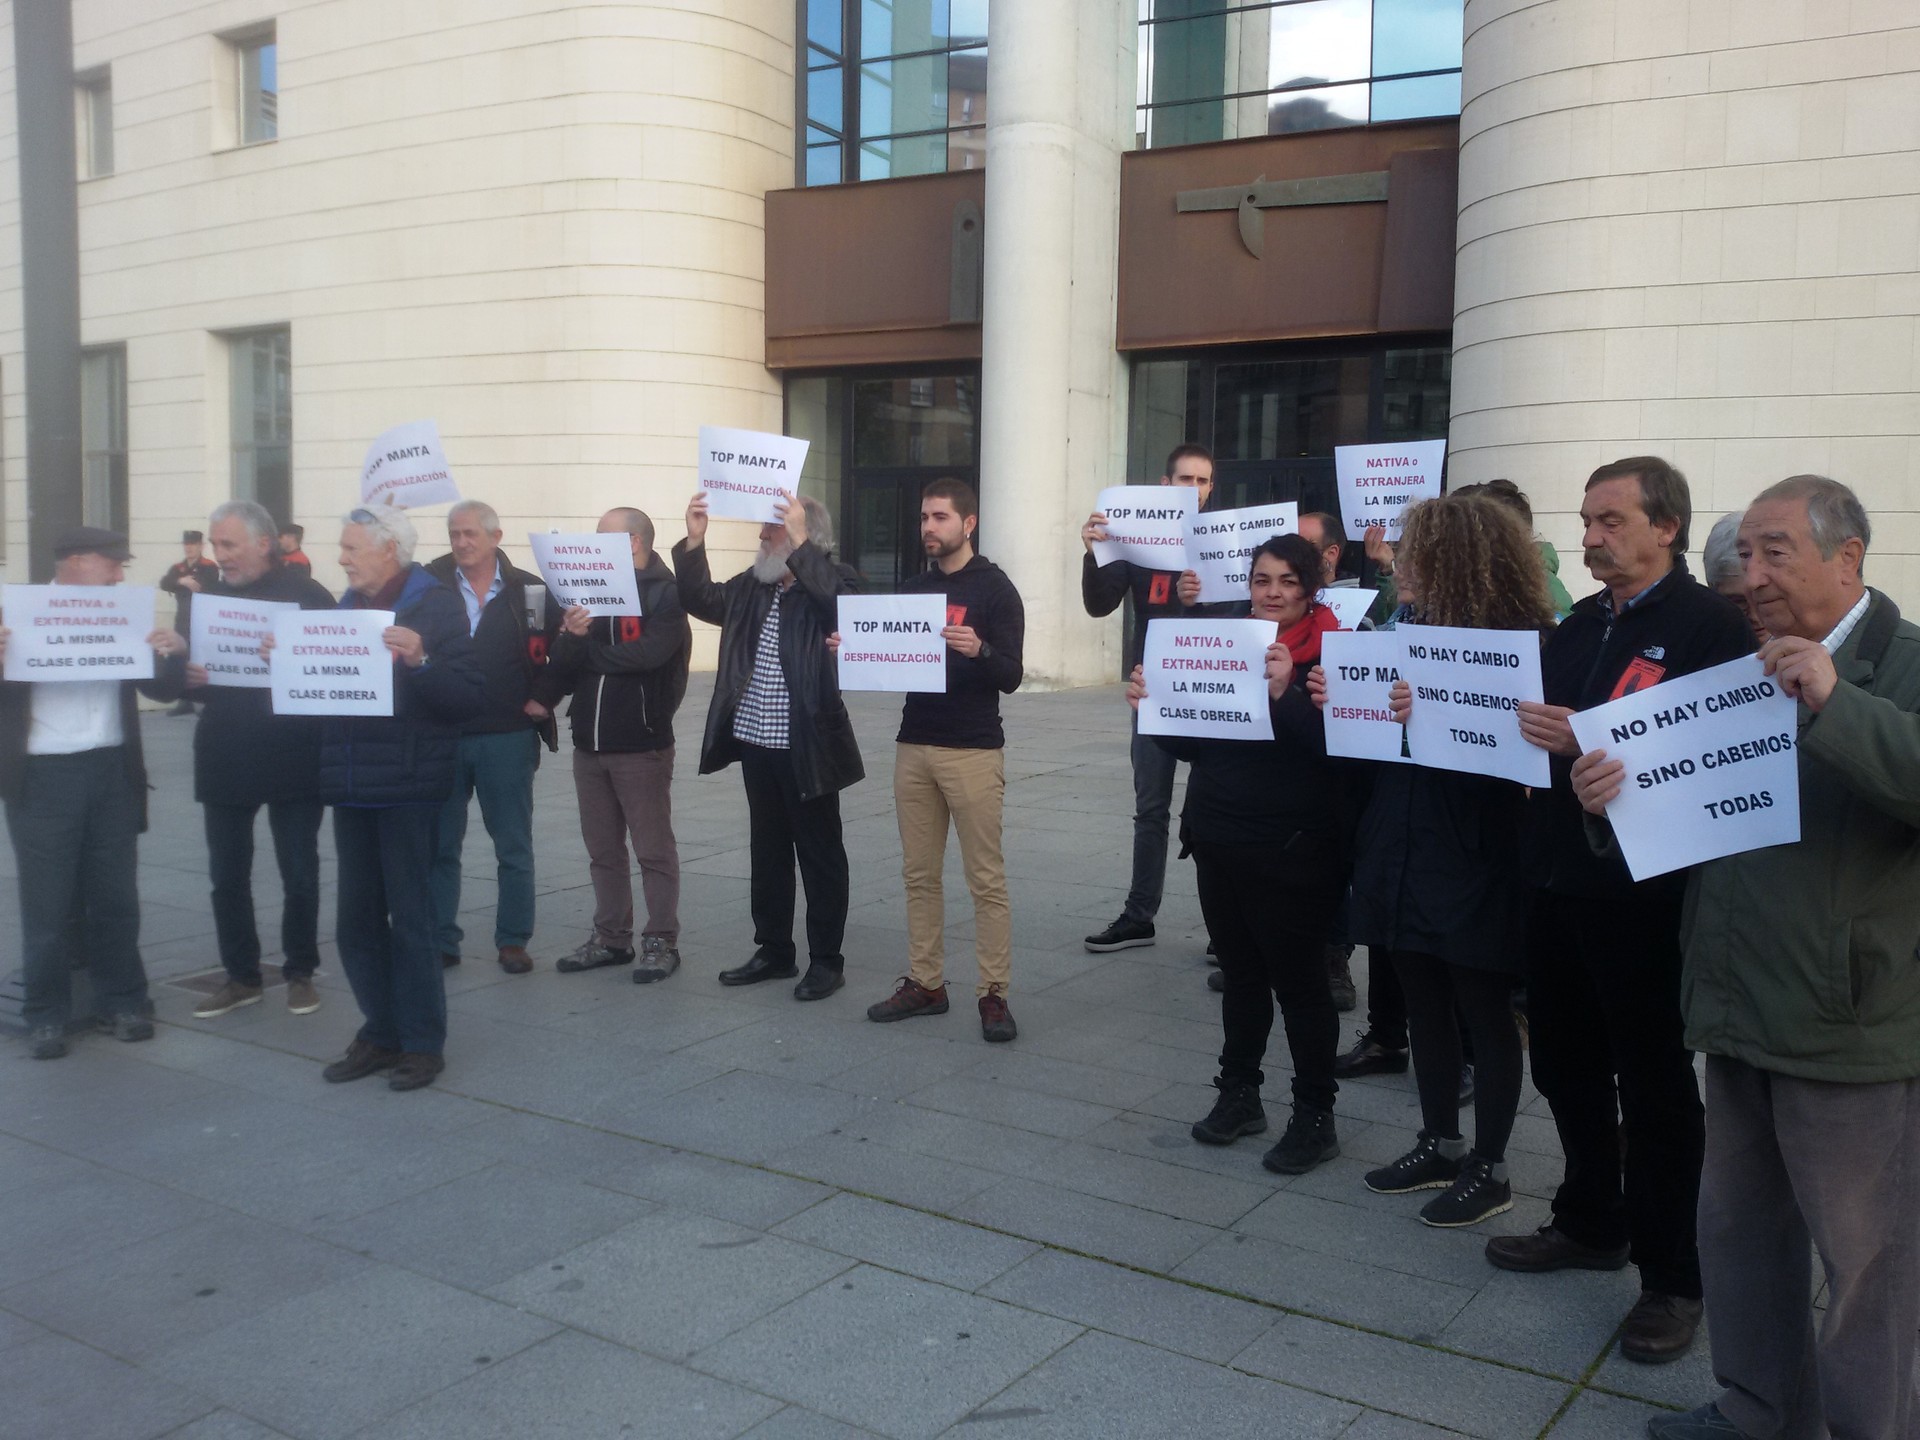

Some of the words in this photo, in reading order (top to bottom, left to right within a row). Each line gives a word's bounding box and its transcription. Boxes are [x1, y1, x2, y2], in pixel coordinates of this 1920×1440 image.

[386, 445, 430, 462] MANTA
[711, 451, 734, 463] TOP
[738, 454, 787, 470] MANTA
[1366, 457, 1409, 468] NATIVA
[1355, 475, 1425, 487] EXTRANJERA
[1364, 496, 1379, 506] LA
[1383, 495, 1413, 505] MISM
[1105, 508, 1131, 518] TOP
[1193, 526, 1207, 535] NO
[1210, 523, 1235, 534] HAY
[1239, 517, 1285, 531] CAMBIO
[1354, 518, 1387, 528] CLASE
[554, 546, 592, 554] NATIVA
[1199, 551, 1224, 560] SINO
[548, 562, 614, 571] EXTRANJERA
[557, 579, 569, 587] LA
[571, 579, 607, 587] MISMA
[1224, 573, 1249, 583] TOD
[48, 599, 103, 608] NATIVA
[580, 597, 625, 605] OBRERA
[33, 617, 128, 626] EXTRANJERA
[218, 609, 258, 622] NATIVA
[303, 626, 346, 635] NATIVA
[853, 621, 878, 633] TOP
[882, 621, 931, 633] MANTA
[46, 635, 64, 644] LA
[68, 635, 116, 644] MISMA
[1175, 636, 1222, 648] NATIVA
[1226, 640, 1234, 648] o
[217, 644, 231, 653] LA
[292, 646, 370, 655] EXTRANJERA
[27, 658, 73, 668] CLASE
[77, 656, 135, 667] OBRERA
[844, 651, 941, 663] DESPENALIZACIÓN
[1409, 645, 1427, 659] NO
[1430, 647, 1457, 662] HAY
[1462, 650, 1520, 668] CAMBIO
[205, 662, 240, 674] CLASE
[243, 666, 271, 676] OBR
[303, 665, 318, 675] LA
[321, 665, 360, 676] MISMA
[1162, 658, 1248, 671] EXTRANJERA
[1338, 666, 1370, 682] TOP
[1172, 681, 1188, 693] LA
[1192, 682, 1235, 694] MISMA
[288, 689, 326, 699] CLASE
[329, 690, 377, 700] OBRERA
[1417, 686, 1449, 703] SINO
[1453, 690, 1520, 712] CABEMOS
[1160, 707, 1197, 720] CLASE
[1200, 710, 1252, 723] OBRERA
[1332, 706, 1394, 722] DESPENAL
[1610, 719, 1648, 744] NO
[1653, 701, 1699, 729] HAY
[1705, 681, 1776, 713] CAMBIO
[1449, 728, 1497, 748] TODAS
[1636, 758, 1696, 789] SINO
[1701, 732, 1792, 770] CABEMOS
[1703, 790, 1774, 820] TODAS
